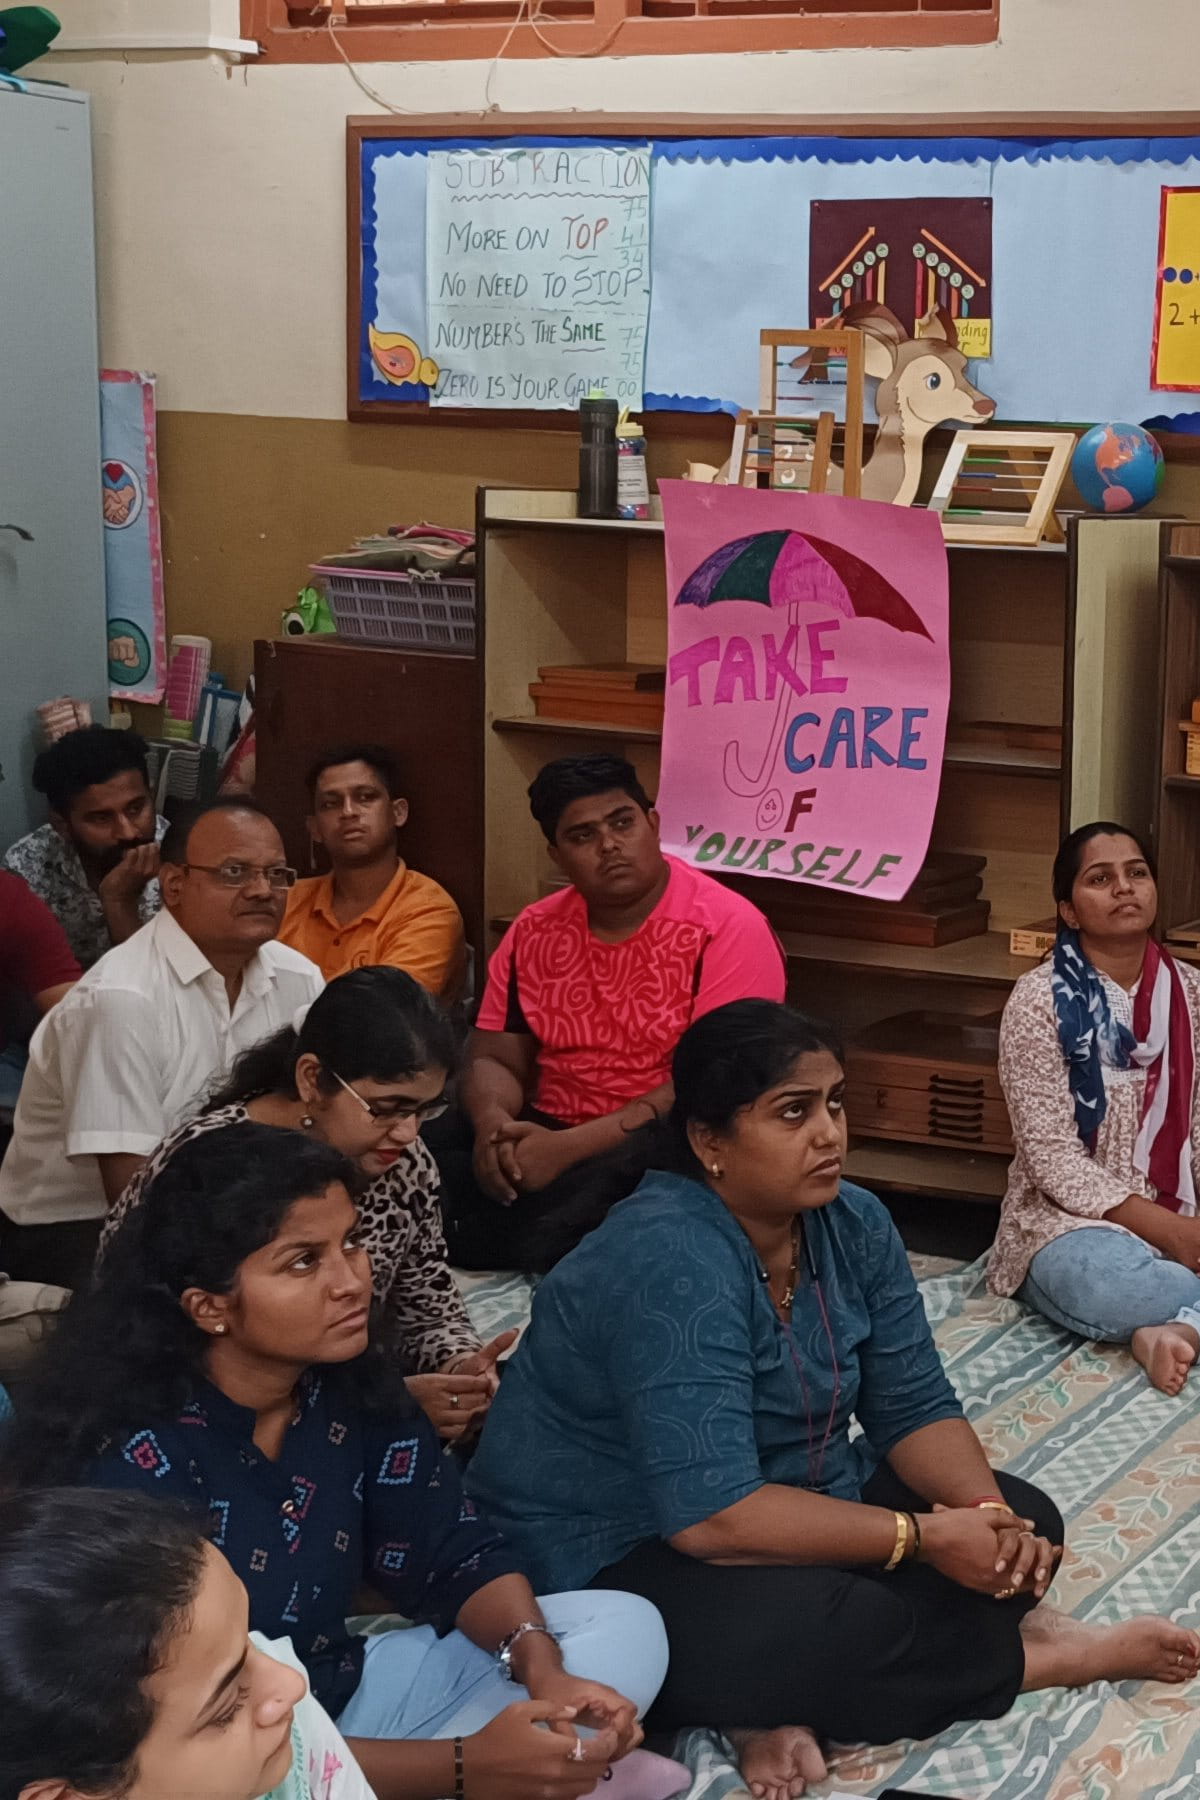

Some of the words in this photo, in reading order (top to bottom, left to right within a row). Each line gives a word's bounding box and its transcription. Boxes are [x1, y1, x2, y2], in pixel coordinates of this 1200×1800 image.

[446, 150, 650, 189] SUBTRACTION
[446, 220, 509, 255] MORE
[516, 226, 550, 251] ON
[561, 213, 609, 251] TOP
[439, 272, 467, 298] NO
[477, 272, 529, 299] NEED
[543, 271, 567, 298] TO
[572, 266, 645, 299] STOP
[531, 319, 557, 345] THE
[560, 315, 608, 342] SAME
[434, 367, 479, 399] ZERO
[486, 375, 506, 401] IS
[510, 372, 560, 401] YOUR
[563, 372, 611, 407] GAME
[669, 619, 849, 708] TAKE
[784, 706, 929, 774] CARE
[685, 825, 904, 890] YOURSELF
